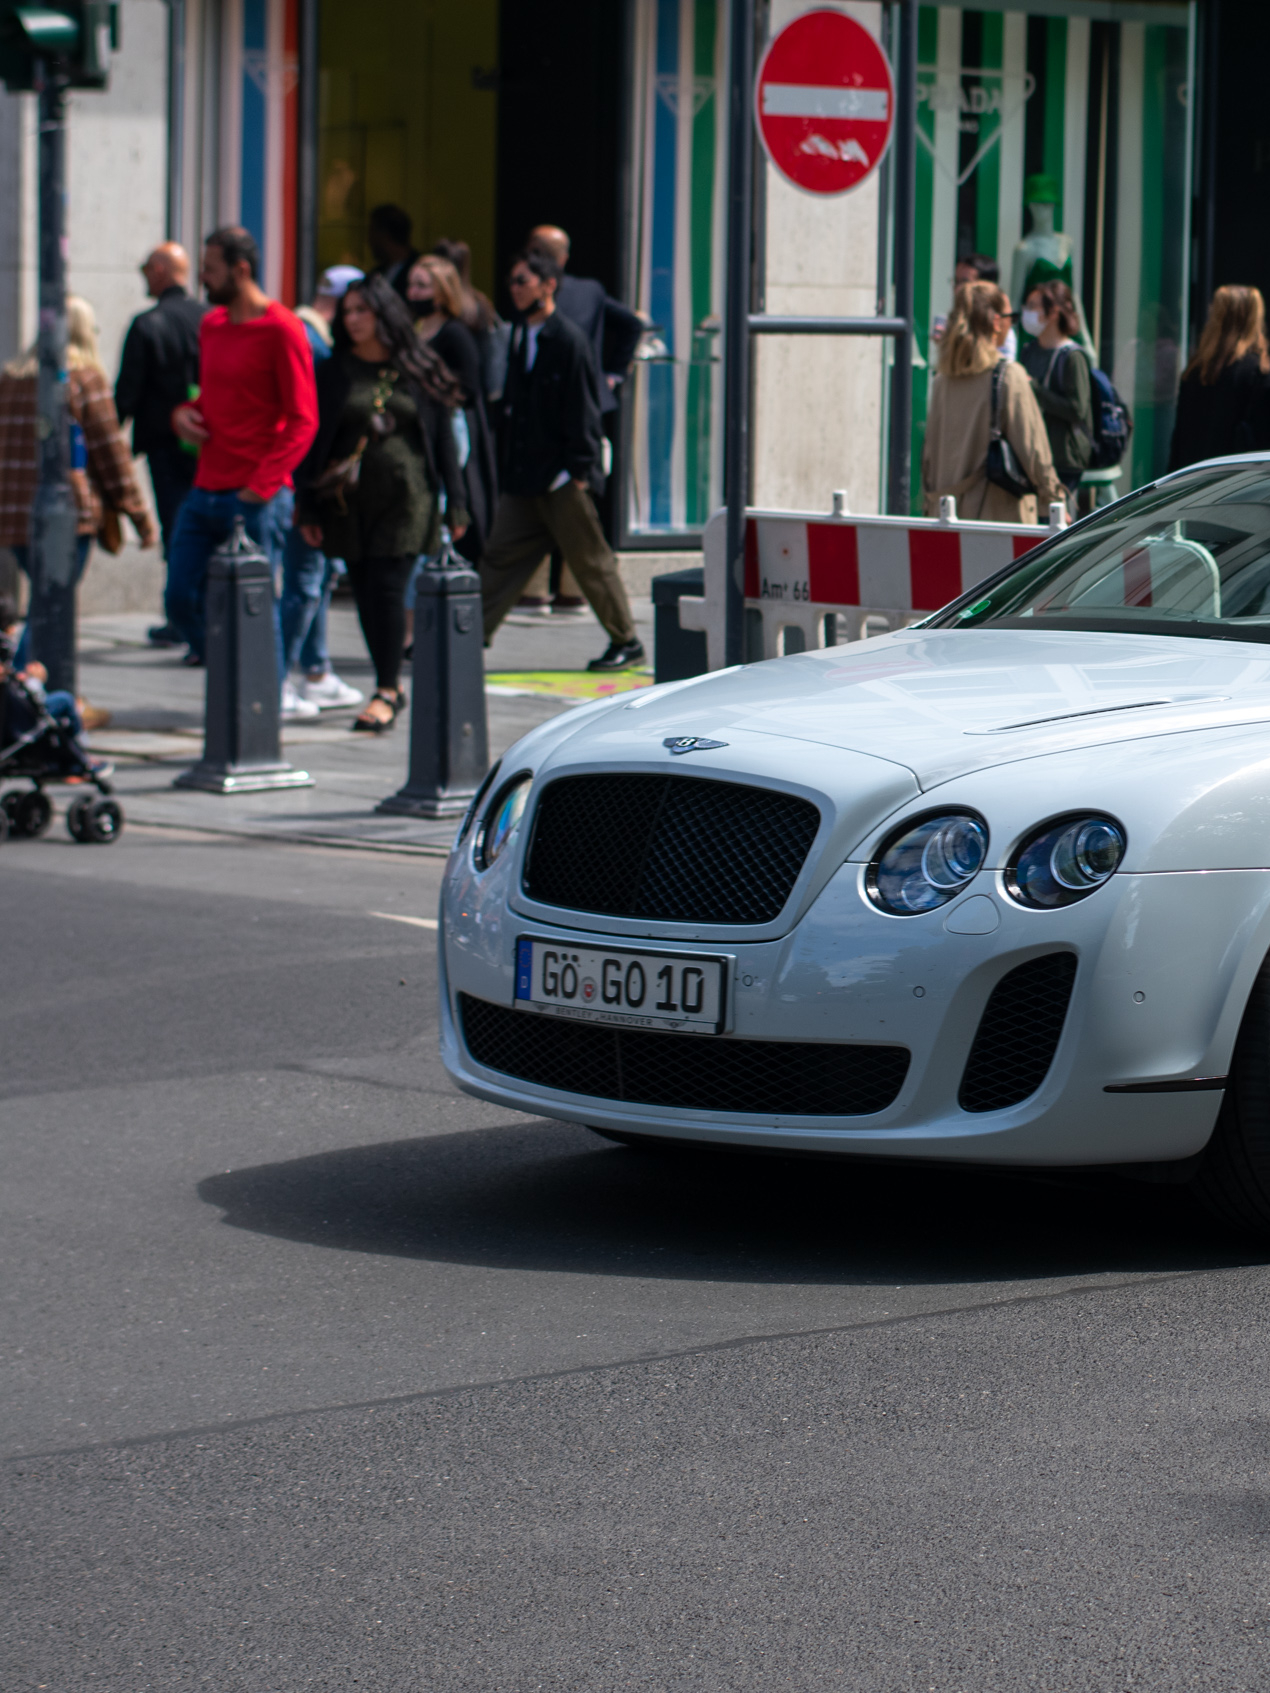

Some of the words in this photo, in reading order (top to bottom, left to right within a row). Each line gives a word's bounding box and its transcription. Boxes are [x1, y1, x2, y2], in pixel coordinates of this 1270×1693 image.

[793, 580, 809, 601] 66
[543, 951, 579, 999] GÖ
[602, 958, 646, 1008] GO
[656, 964, 704, 1014] 10
[556, 1007, 593, 1019] BENTLEY
[601, 1013, 654, 1026] HANNOVER
